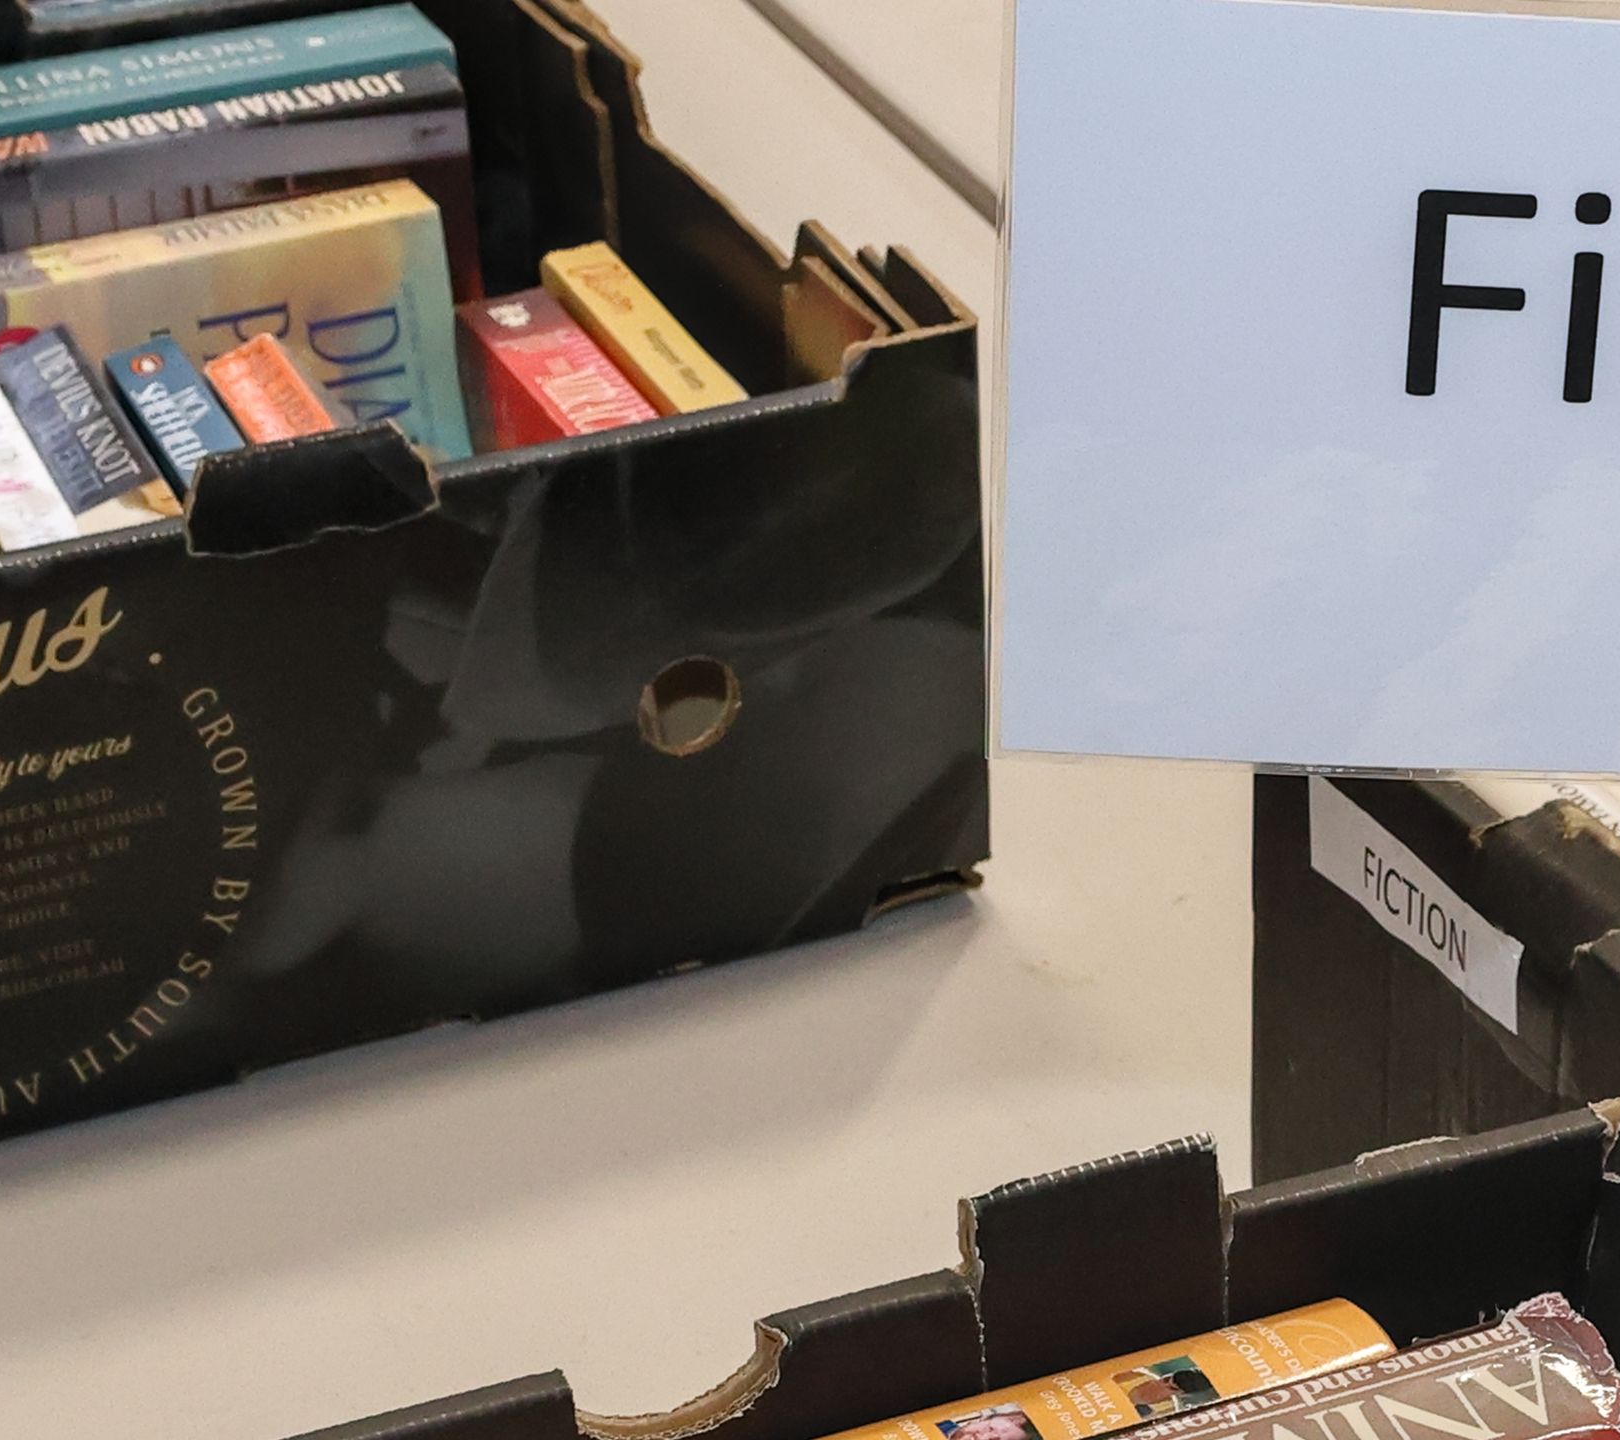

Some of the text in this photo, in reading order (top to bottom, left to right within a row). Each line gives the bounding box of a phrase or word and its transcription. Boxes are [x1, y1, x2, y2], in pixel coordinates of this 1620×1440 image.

[80, 70, 405, 148] JONATHAN RABAN
[16, 752, 45, 777] to
[46, 735, 133, 781] yours
[182, 686, 258, 851] GROWN
[203, 877, 250, 935] BY
[1363, 846, 1470, 972] FICTION
[67, 951, 213, 1086] SOUTH
